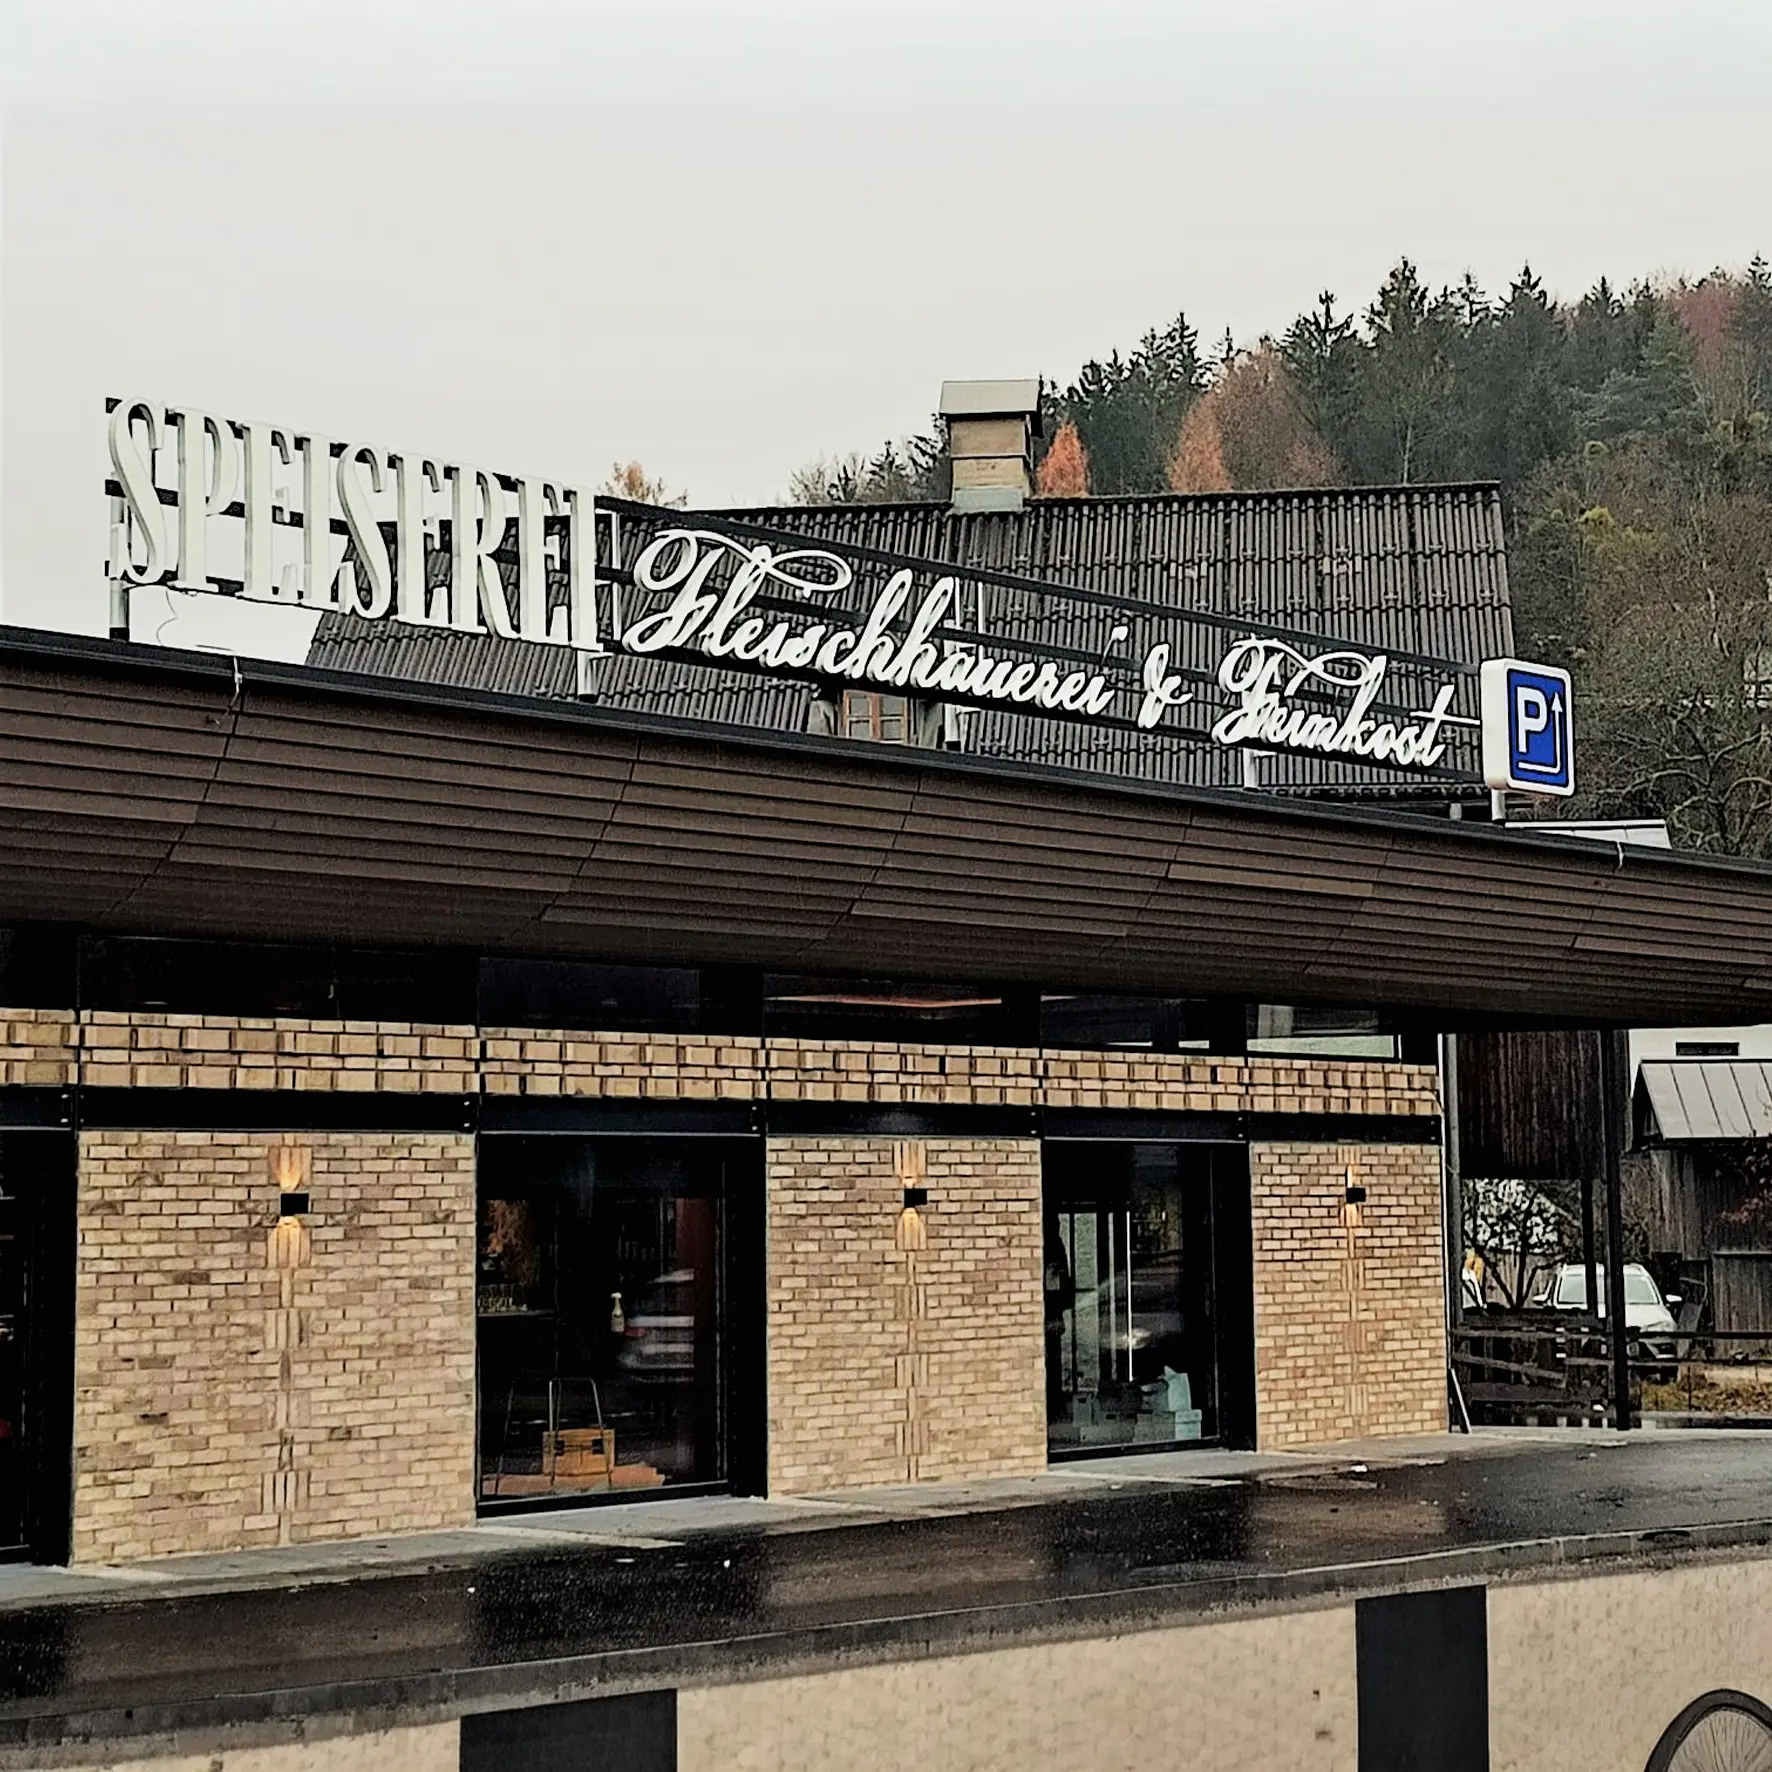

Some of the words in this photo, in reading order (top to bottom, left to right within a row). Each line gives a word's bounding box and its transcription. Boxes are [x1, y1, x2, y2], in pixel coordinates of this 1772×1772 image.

[108, 397, 603, 651] SPEISEREI
[622, 529, 1128, 714] Fleischhauerei
[1212, 633, 1478, 768] Feinkost
[1515, 685, 1549, 753] P
